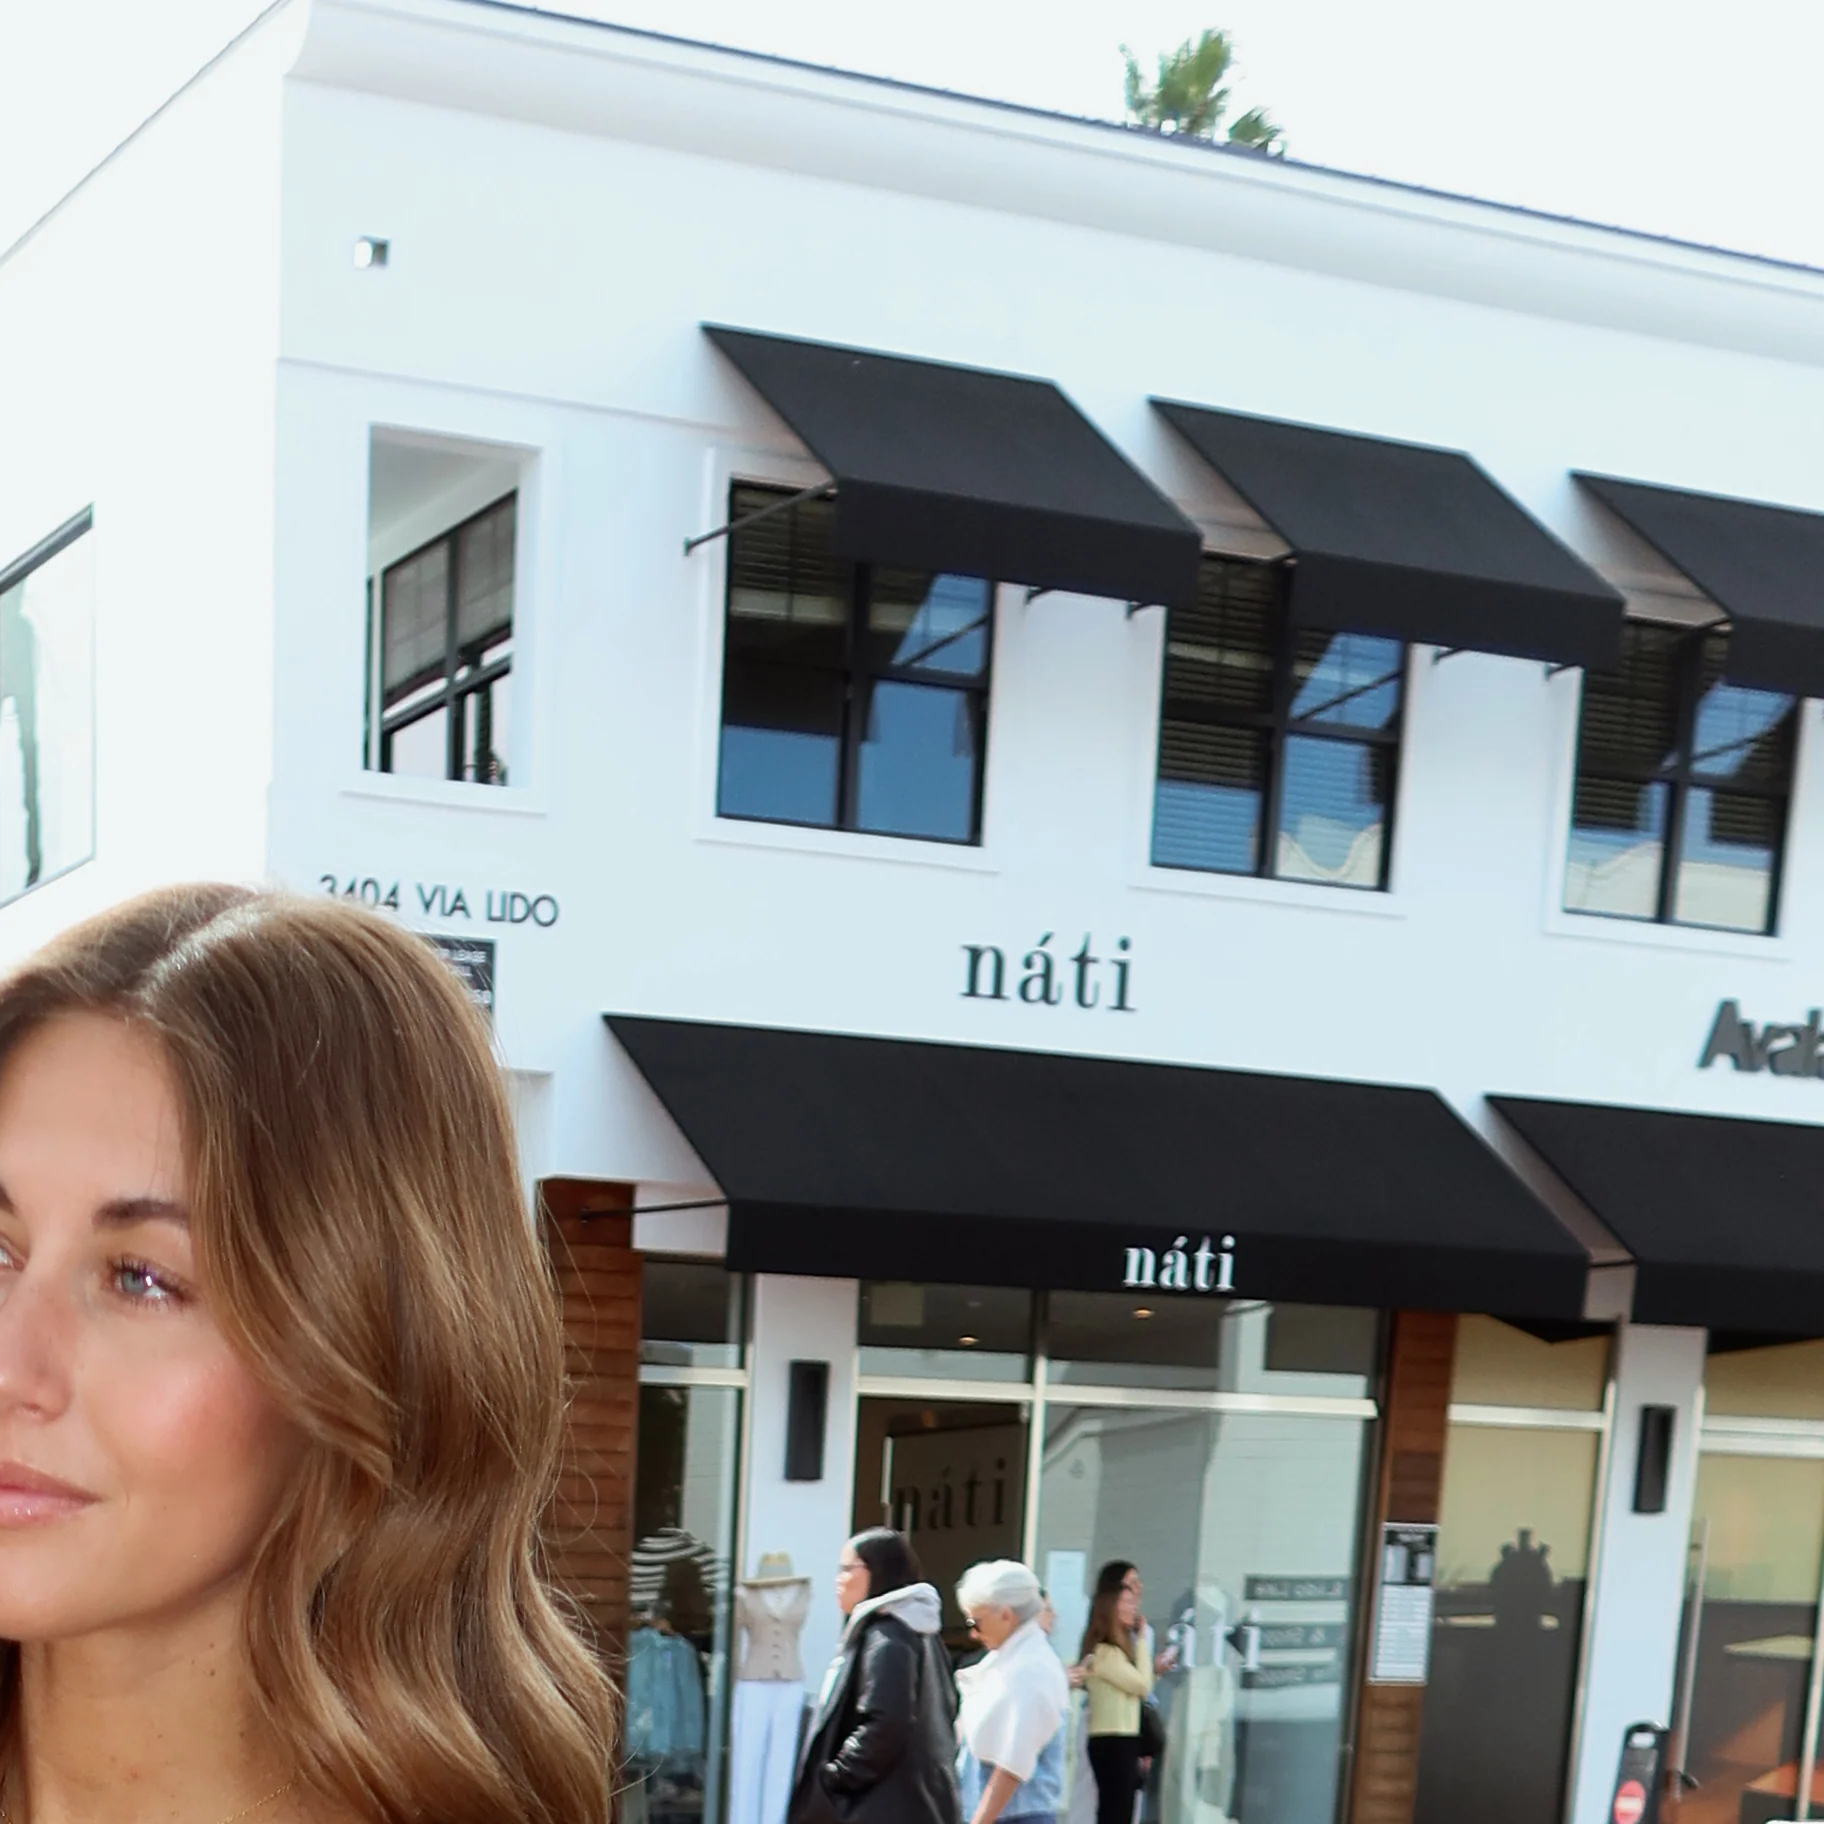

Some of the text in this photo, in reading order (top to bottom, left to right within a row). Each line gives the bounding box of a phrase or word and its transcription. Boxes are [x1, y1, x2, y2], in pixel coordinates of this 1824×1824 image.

[416, 882, 471, 919] VIA
[486, 889, 559, 928] LIDO
[958, 930, 1139, 1013] náti
[1122, 1234, 1237, 1293] náti
